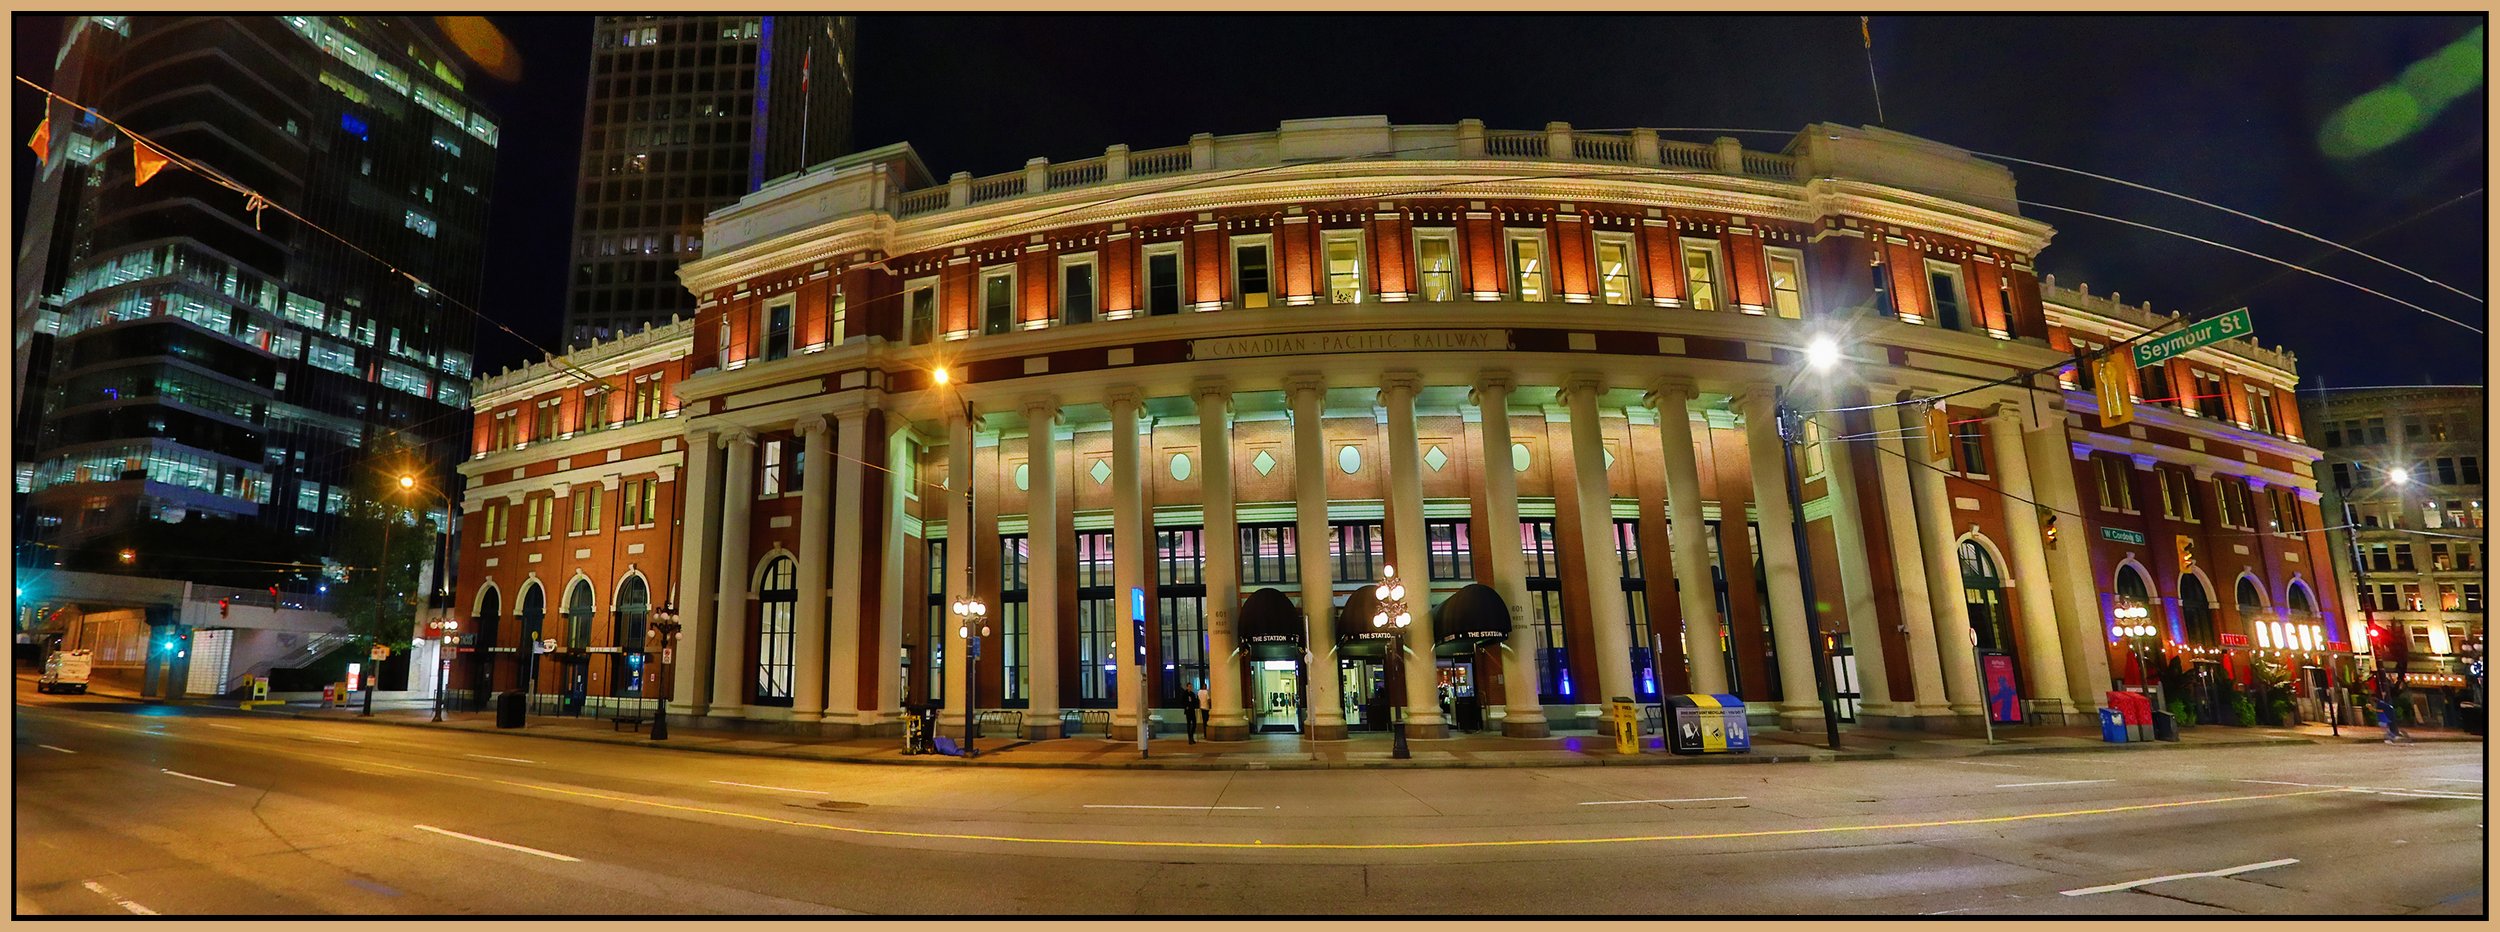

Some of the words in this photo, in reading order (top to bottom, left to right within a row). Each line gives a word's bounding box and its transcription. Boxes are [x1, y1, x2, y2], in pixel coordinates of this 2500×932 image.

[1213, 338, 1306, 355] CANADIAN
[1322, 333, 1397, 350] PACIFIC
[1413, 333, 1488, 348] RAILWAY
[2141, 325, 2212, 360] Seymour
[2220, 316, 2242, 334] St
[2255, 621, 2325, 651] ROGUE
